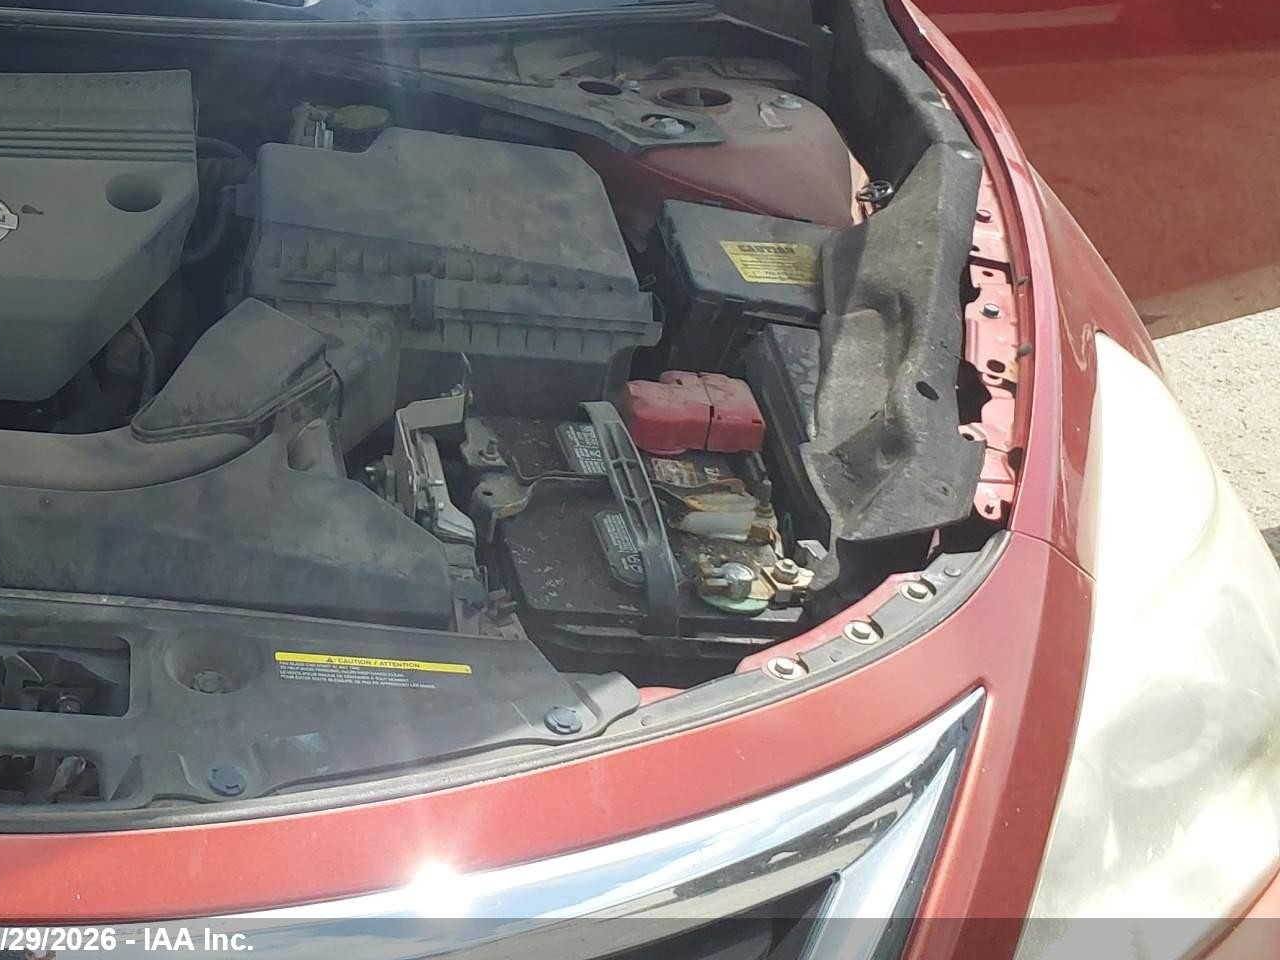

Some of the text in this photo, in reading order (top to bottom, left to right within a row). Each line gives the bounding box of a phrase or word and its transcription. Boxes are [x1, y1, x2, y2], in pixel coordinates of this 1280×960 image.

[738, 244, 795, 255] CAUTION
[338, 657, 372, 666] CAUTION
[380, 660, 420, 668] ATTENTION
